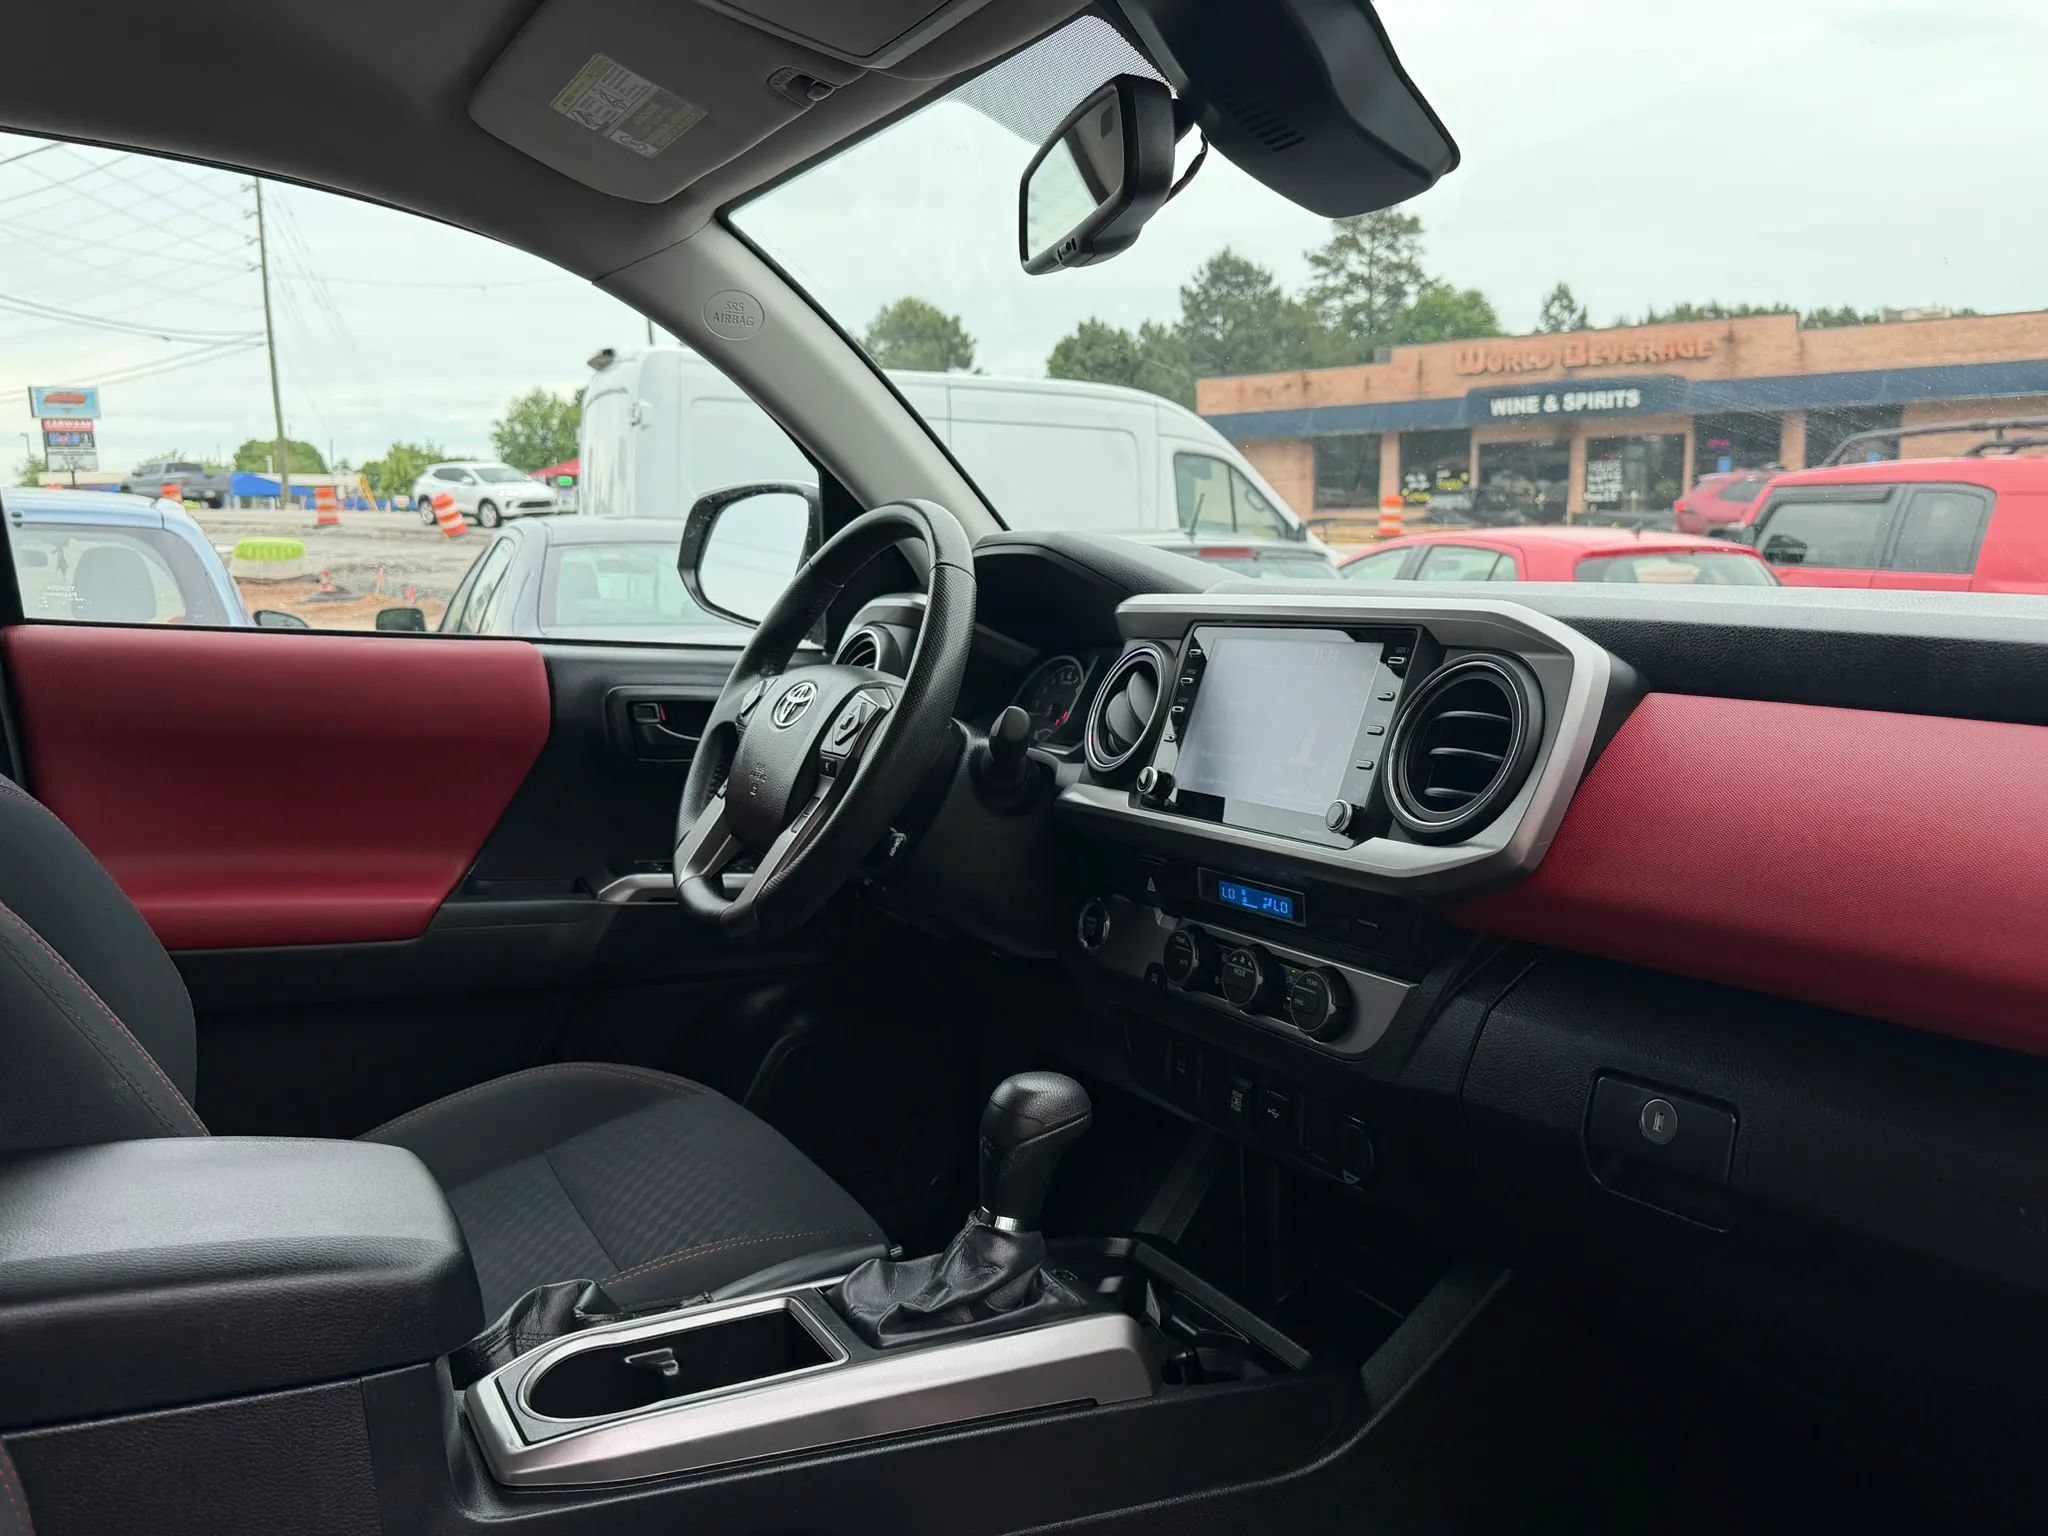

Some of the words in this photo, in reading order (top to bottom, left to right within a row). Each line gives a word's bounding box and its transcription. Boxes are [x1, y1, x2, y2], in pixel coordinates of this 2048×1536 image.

[713, 312, 754, 328] AIRBAG
[725, 301, 745, 312] SRS
[1456, 347, 1554, 376] WORLD
[1563, 339, 1713, 367] BEVERAGE
[1490, 395, 1540, 417] WINE
[1543, 394, 1560, 413] &
[1562, 389, 1641, 412] SPIRITS
[1221, 886, 1236, 900] LO
[1273, 899, 1289, 914] LO
